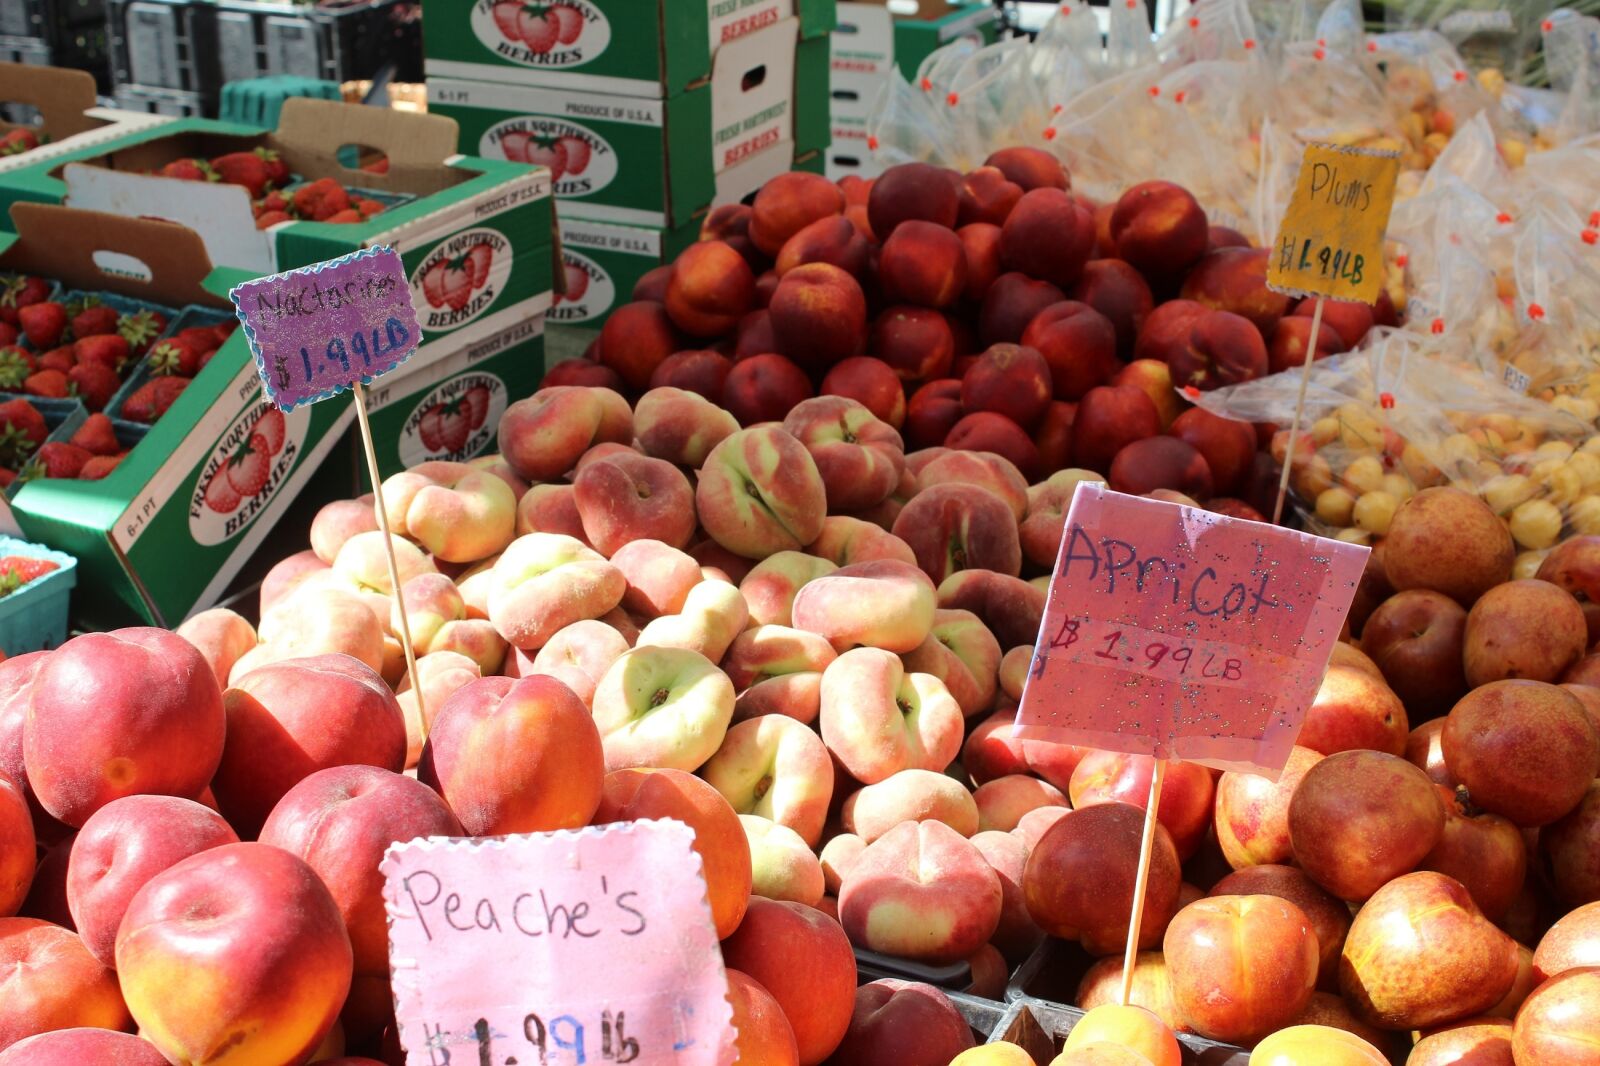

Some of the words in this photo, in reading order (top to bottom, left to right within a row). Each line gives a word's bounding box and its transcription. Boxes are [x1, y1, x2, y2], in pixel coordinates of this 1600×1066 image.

[721, 5, 778, 44] BERRIES
[496, 42, 583, 65] BERRIES
[565, 102, 610, 118] PRODUCE
[613, 108, 624, 119] OF
[488, 120, 527, 145] FRESH
[531, 120, 609, 155] NORTHWEST
[724, 125, 780, 168] BERRIES
[474, 197, 509, 219] PRODUCE
[510, 190, 520, 203] OF
[552, 178, 592, 195] RIES
[1310, 162, 1373, 212] Plums
[564, 231, 607, 246] PRODUCE
[609, 237, 622, 248] OF
[412, 247, 445, 290] FRESH
[447, 232, 508, 256] NORTHWEST
[426, 284, 494, 328] BERRIES
[545, 304, 589, 320] RIES
[405, 393, 438, 437] FRESH
[440, 375, 500, 400] NORTHWEST
[190, 459, 220, 520] FRESH
[224, 440, 297, 539] BERRIES
[127, 514, 145, 538] 6-1
[143, 497, 157, 517] PT
[402, 869, 647, 941] Peache's
